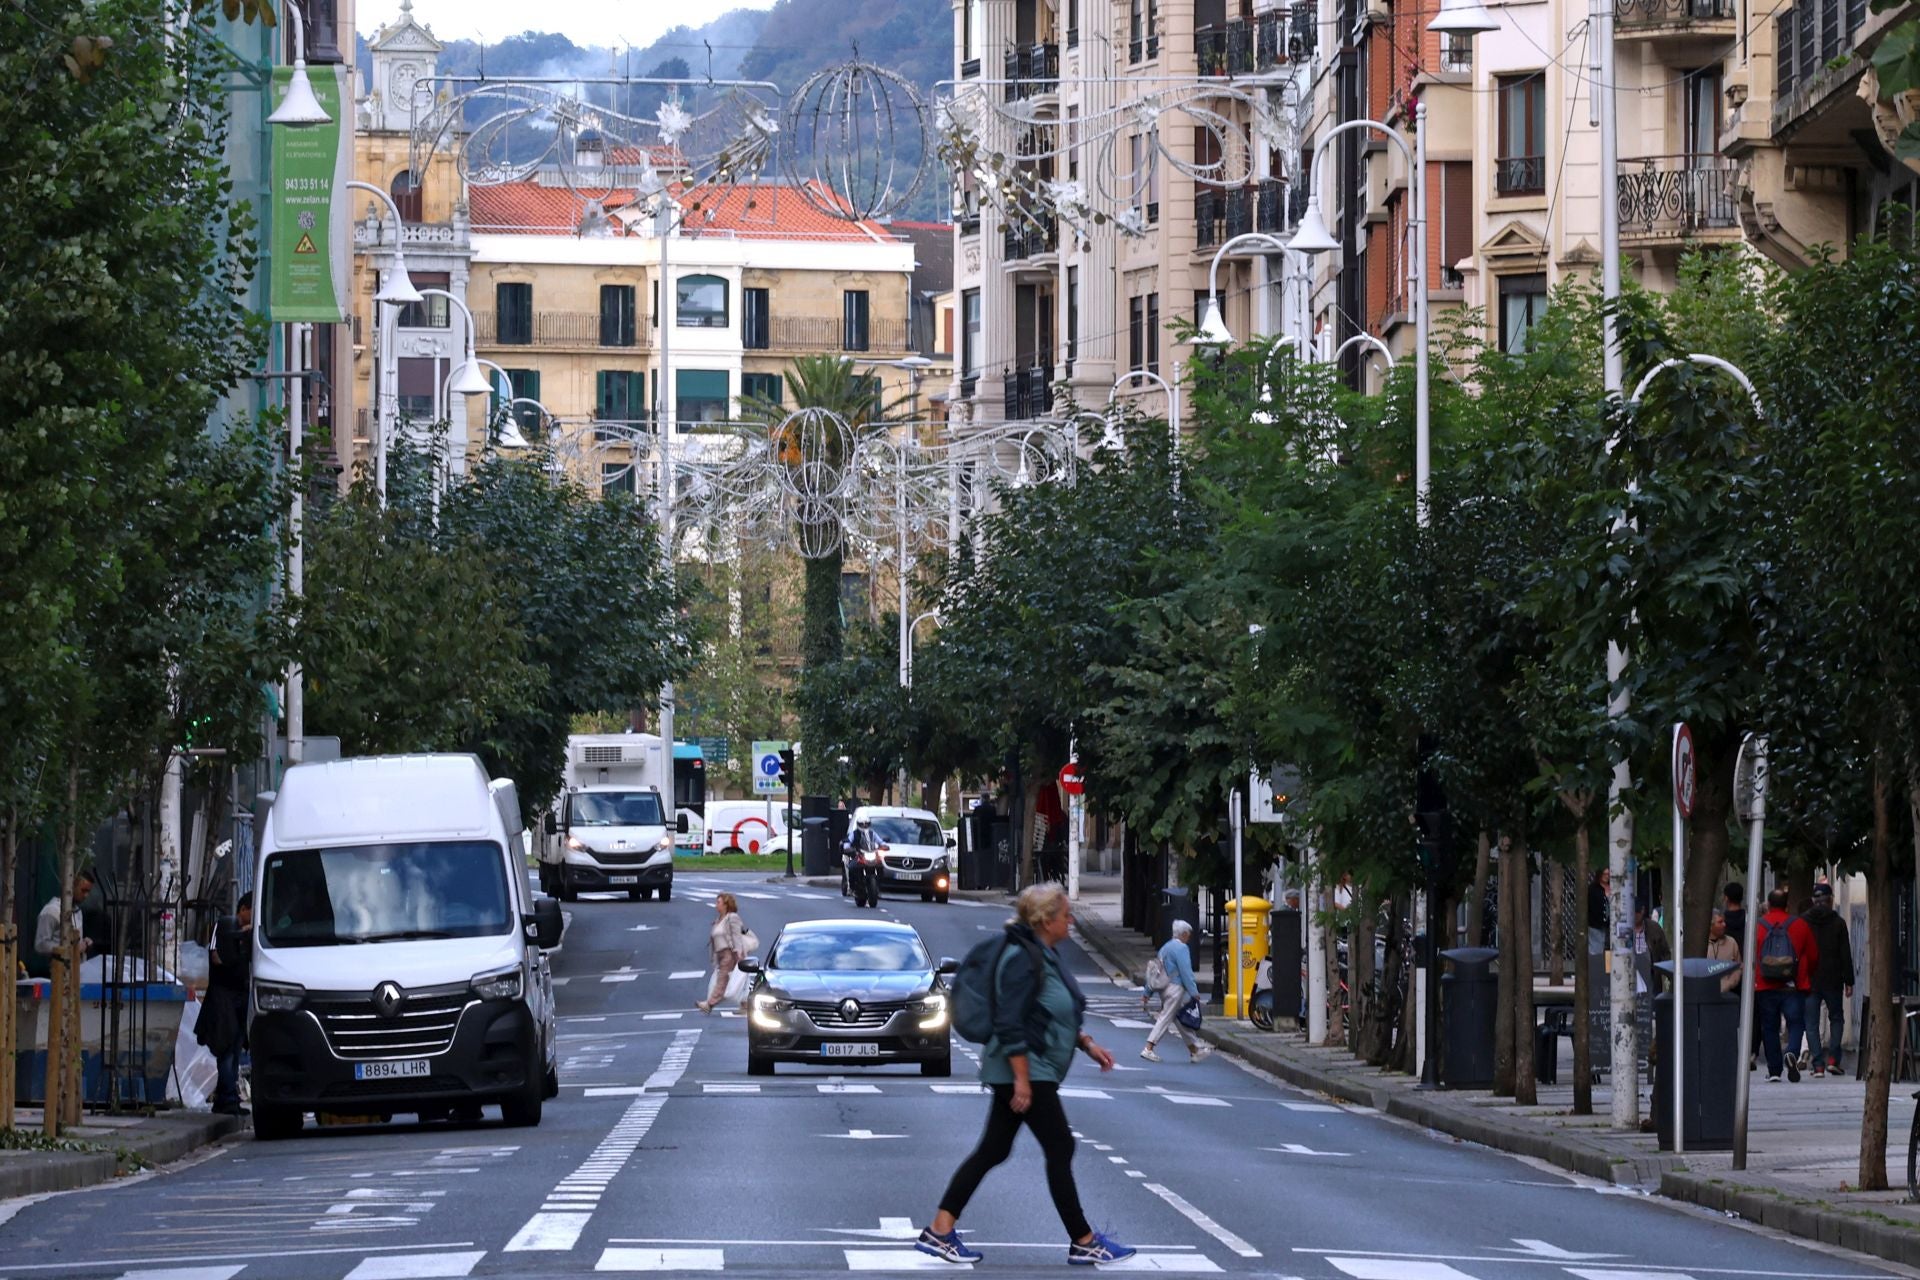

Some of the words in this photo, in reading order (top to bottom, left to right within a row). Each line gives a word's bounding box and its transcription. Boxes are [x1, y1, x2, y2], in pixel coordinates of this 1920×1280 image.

[285, 178, 298, 190] 943
[299, 178, 309, 190] 33
[310, 178, 318, 190] 51
[320, 178, 329, 190] 14
[285, 195, 330, 205] www.zelan.es
[828, 1045, 854, 1055] 0817
[858, 1045, 876, 1055] JLS
[365, 1064, 397, 1077] 8894
[402, 1061, 426, 1074] LHR
